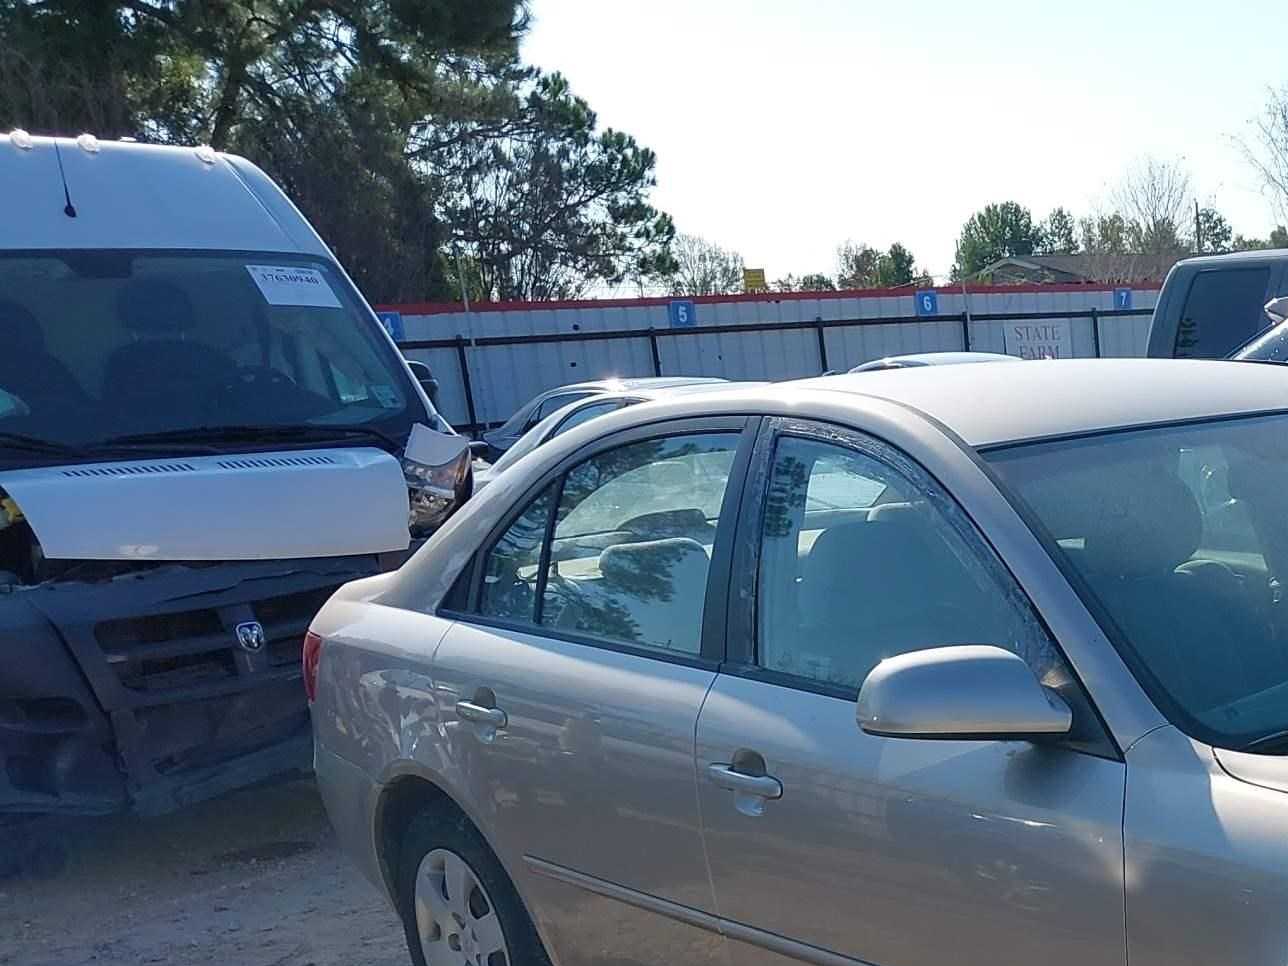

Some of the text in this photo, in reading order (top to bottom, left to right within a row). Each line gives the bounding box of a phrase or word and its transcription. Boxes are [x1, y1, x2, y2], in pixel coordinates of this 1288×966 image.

[923, 295, 932, 311] 6
[1120, 291, 1128, 306] 7
[678, 304, 688, 322] 5
[1014, 326, 1061, 341] STATE
[1017, 344, 1060, 360] FARM
